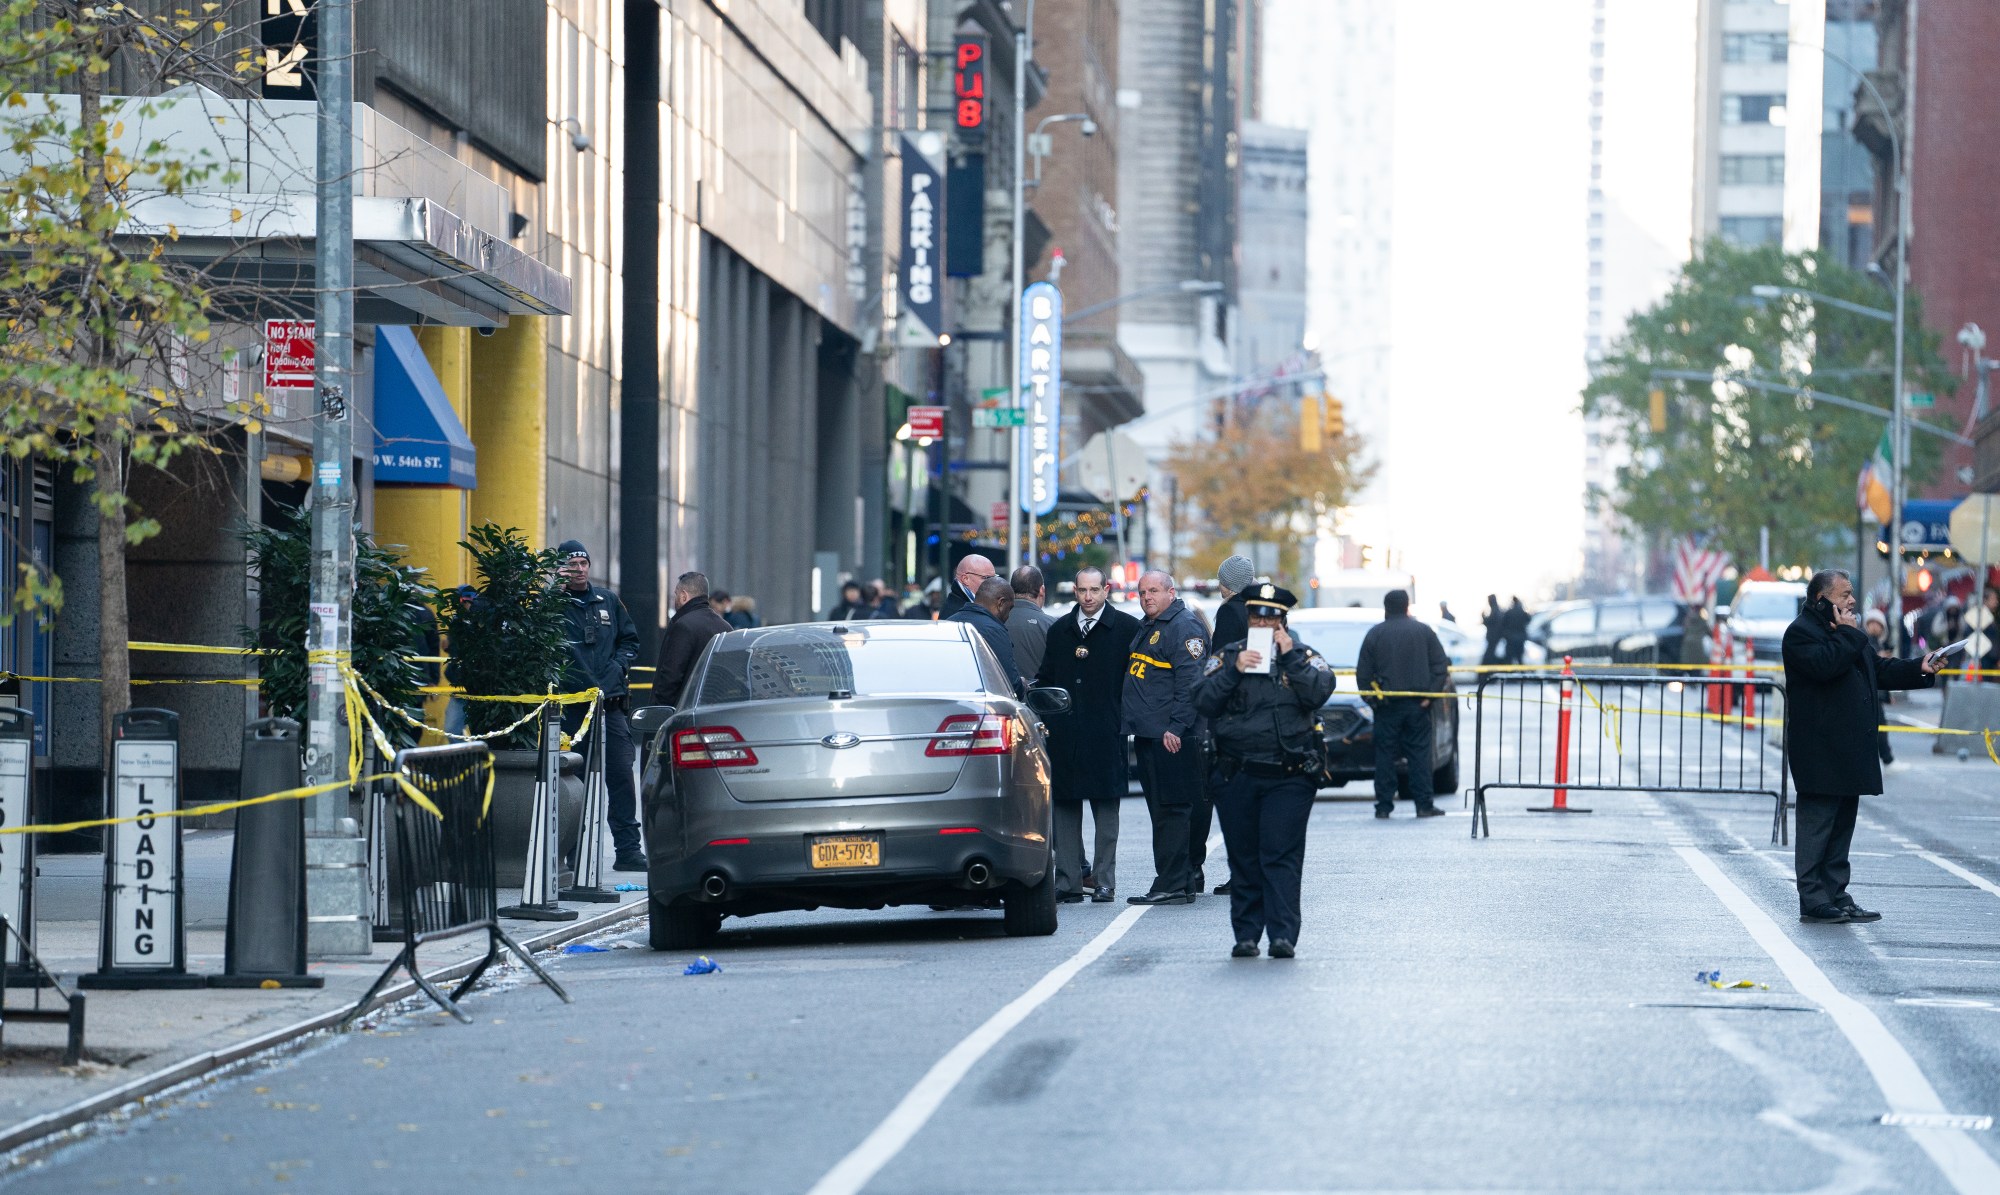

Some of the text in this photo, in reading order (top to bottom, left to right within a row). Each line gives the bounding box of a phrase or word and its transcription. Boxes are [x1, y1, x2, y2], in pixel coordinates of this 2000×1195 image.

[910, 173, 933, 304] PARKING
[270, 326, 285, 339] NO
[270, 343, 291, 353] Hotel
[270, 356, 300, 367] Loading
[382, 455, 396, 467] W.
[399, 456, 422, 468] 54th
[424, 457, 442, 469] ST.
[134, 783, 156, 956] LOADING
